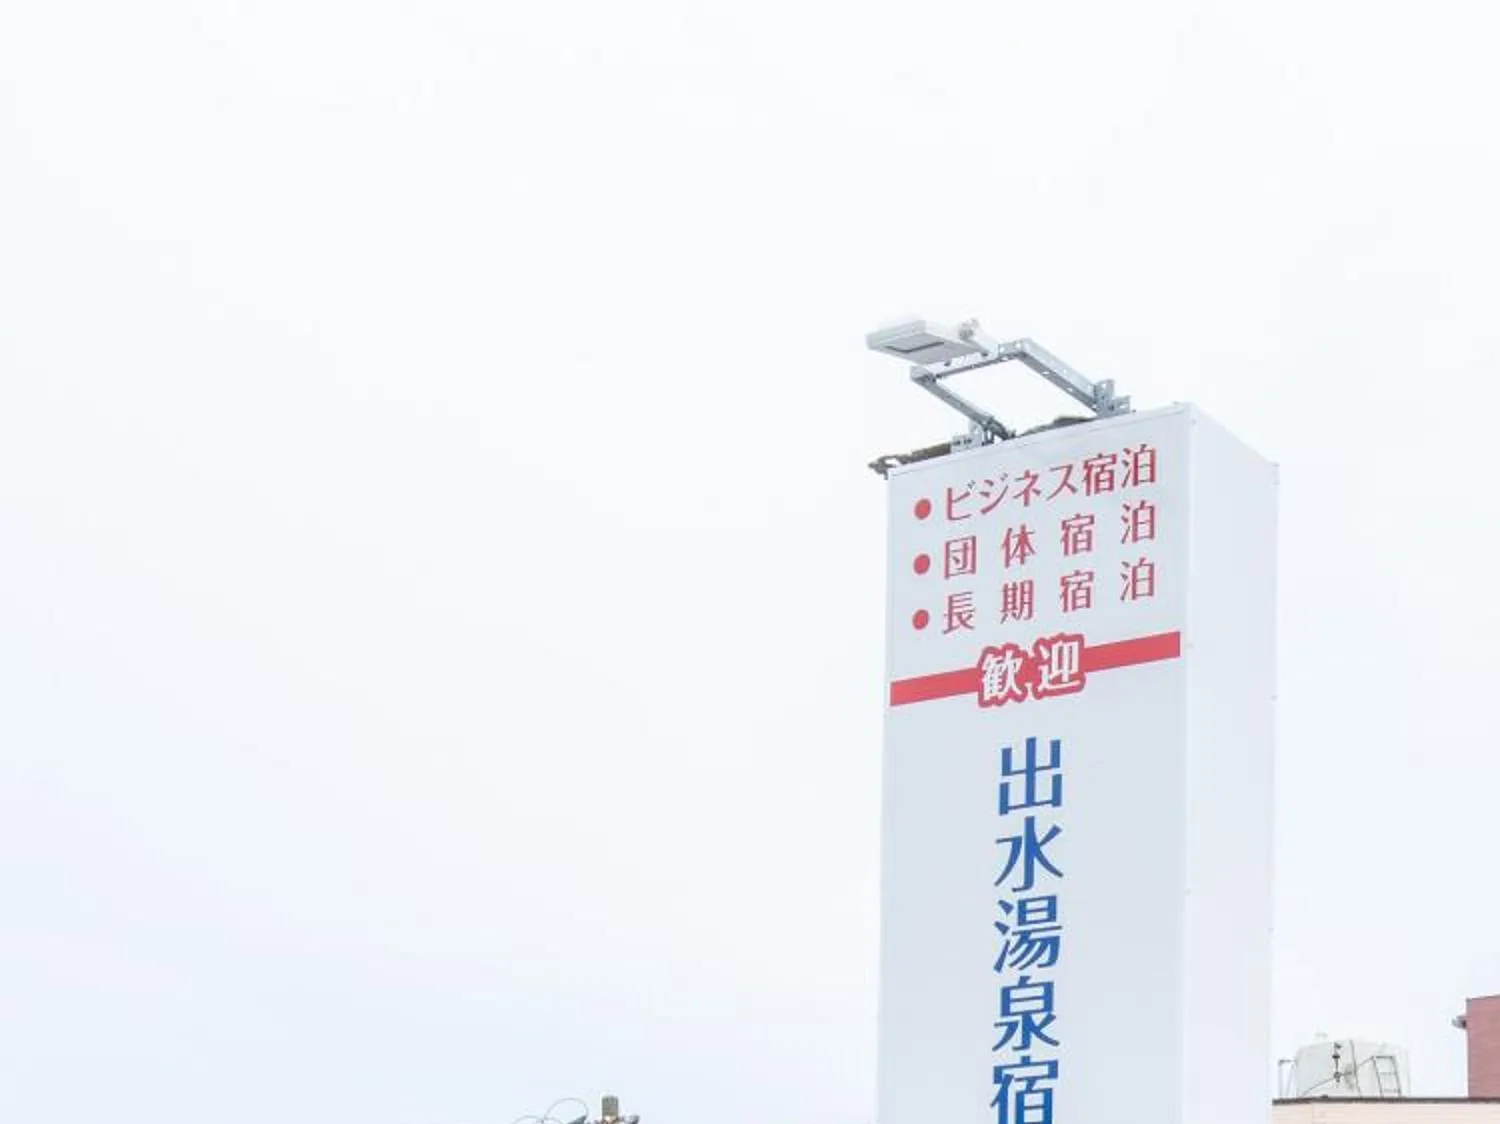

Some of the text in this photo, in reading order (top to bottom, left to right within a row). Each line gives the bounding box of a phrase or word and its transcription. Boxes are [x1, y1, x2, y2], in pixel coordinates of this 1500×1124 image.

[945, 443, 1157, 522] ビジネス宿泊
[943, 499, 1156, 581] 団体宿泊
[941, 556, 1155, 635] 長期宿泊
[981, 639, 1080, 699] 歓迎
